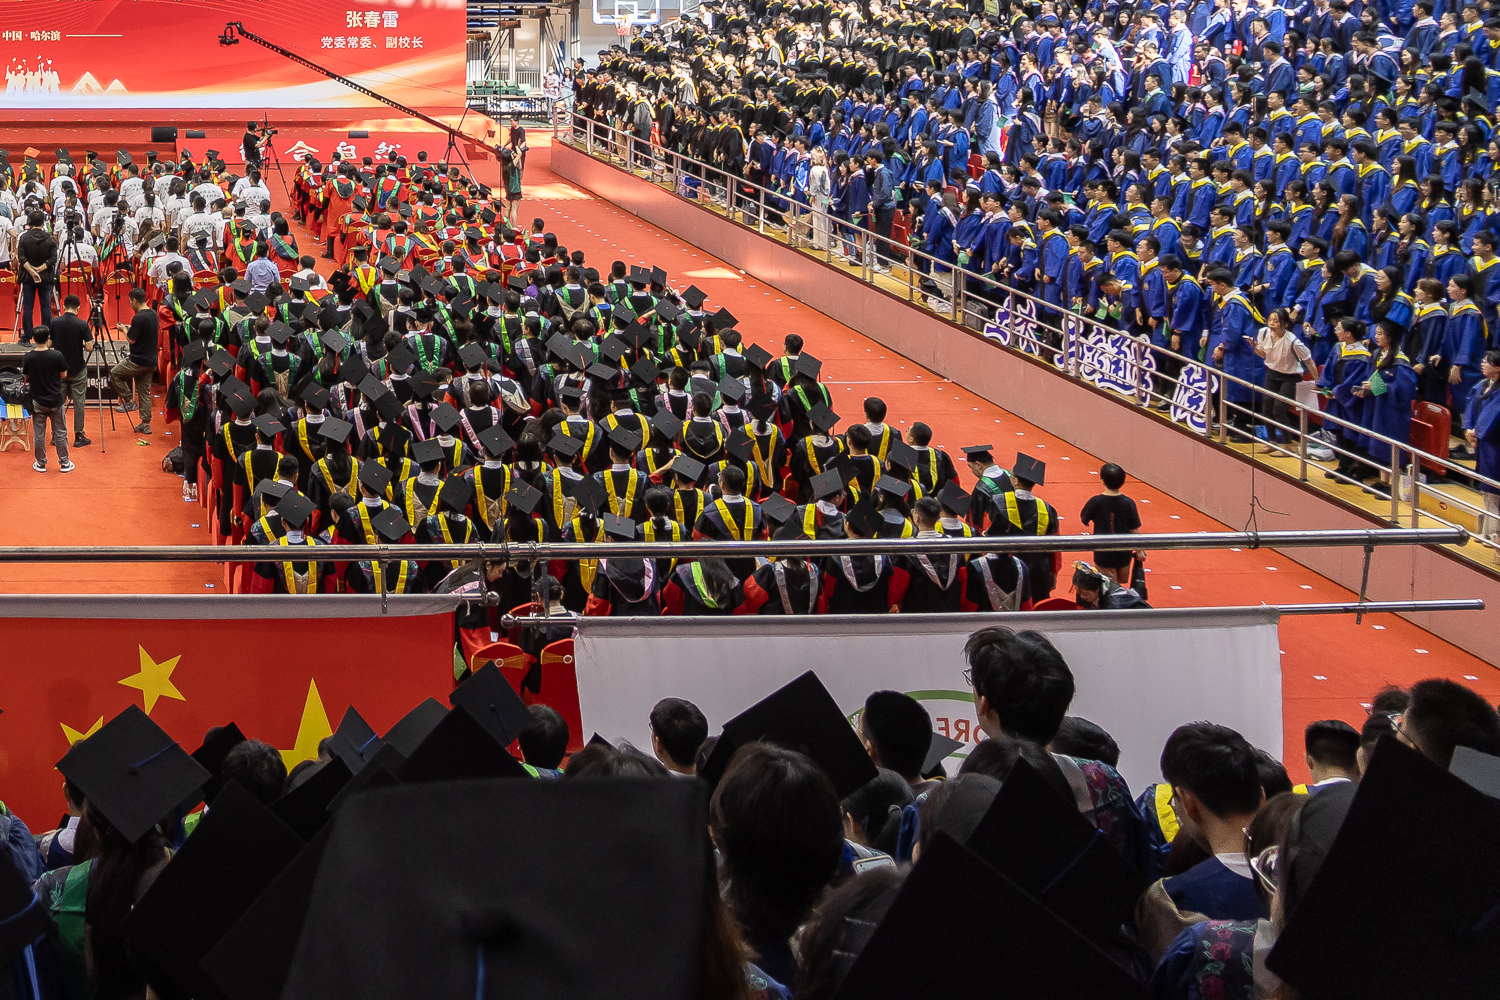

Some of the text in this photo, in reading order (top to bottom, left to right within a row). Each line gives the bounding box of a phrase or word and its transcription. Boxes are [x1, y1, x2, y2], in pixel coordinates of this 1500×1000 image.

[346, 10, 399, 29] 张春雷
[2, 30, 61, 42] 中国·哈尔滨
[320, 35, 424, 49] 党委常委、副校长
